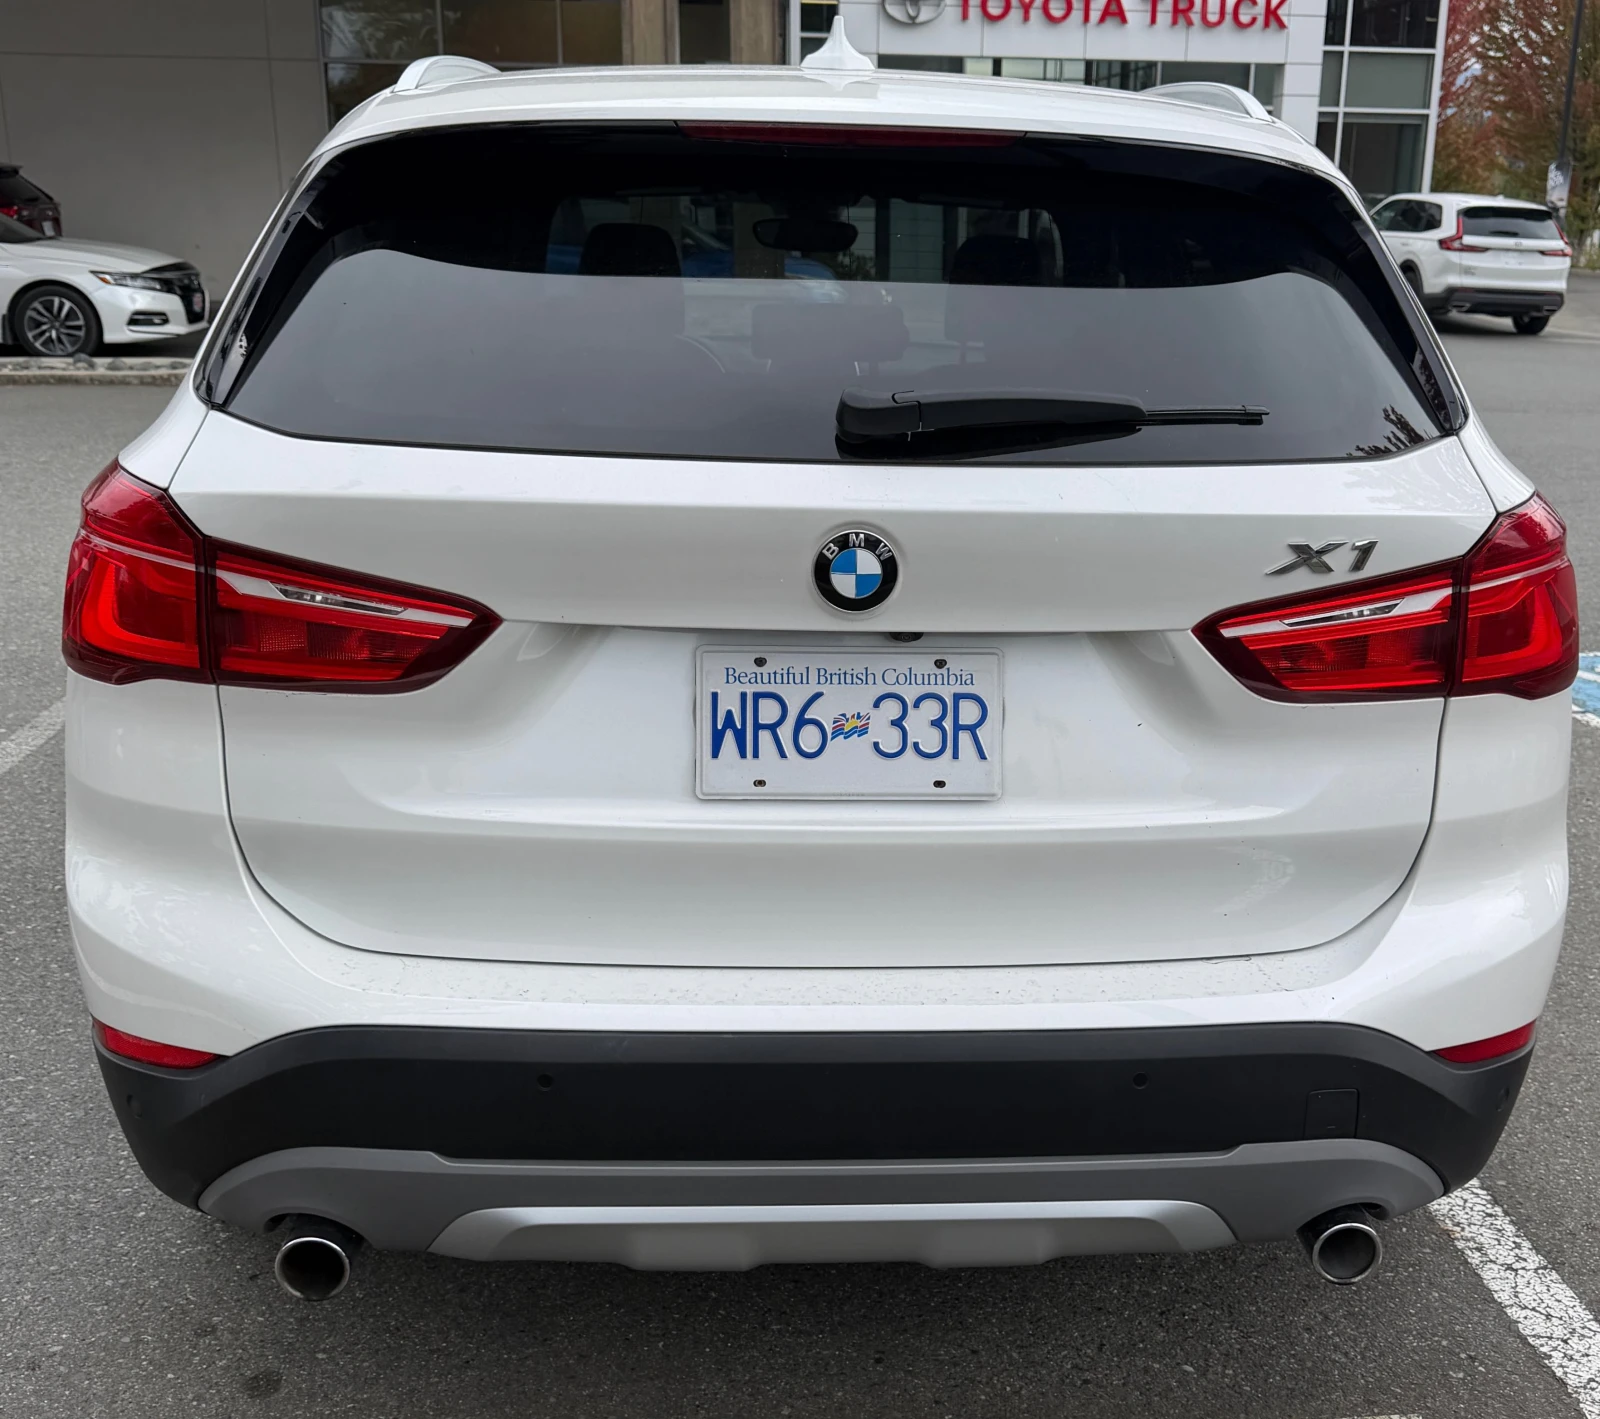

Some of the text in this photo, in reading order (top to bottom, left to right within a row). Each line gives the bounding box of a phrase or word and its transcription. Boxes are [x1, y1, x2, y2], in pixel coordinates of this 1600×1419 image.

[960, 0, 1288, 30] TOYOTA TRUCK
[822, 533, 893, 561] BMW
[1264, 540, 1379, 575] X1
[724, 667, 975, 686] Beautiful British Columbia
[711, 691, 989, 761] WR6 33R
